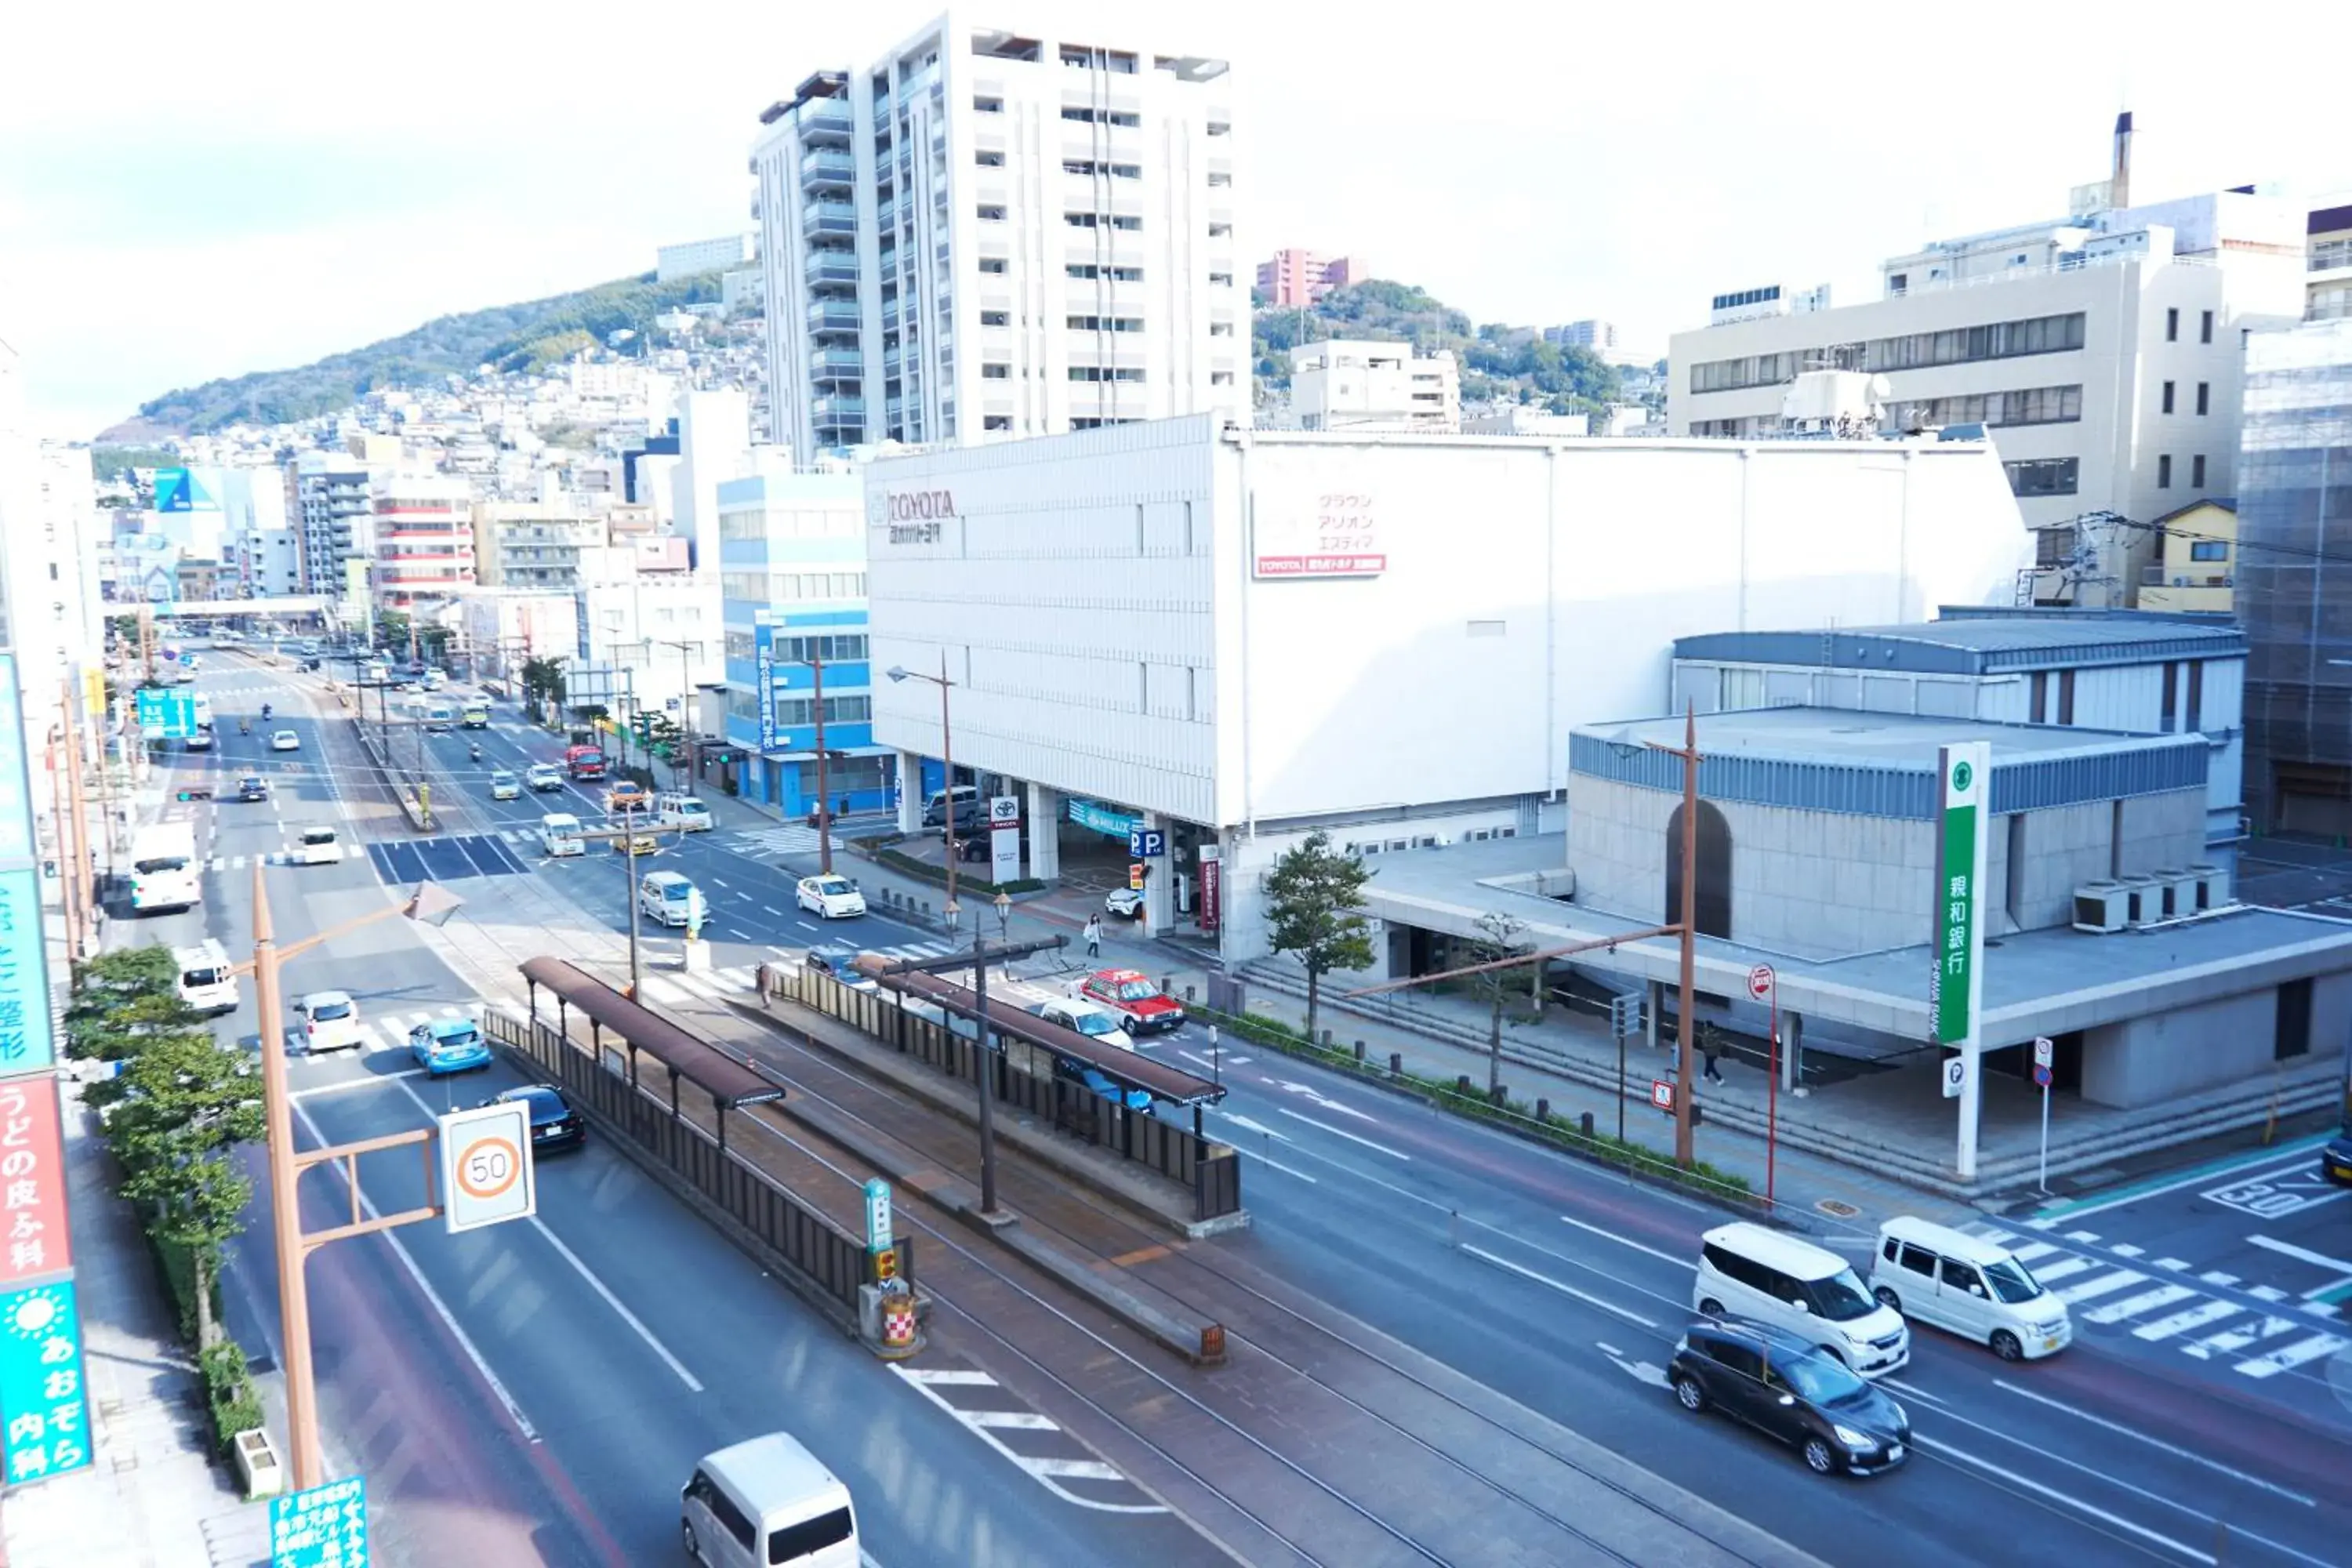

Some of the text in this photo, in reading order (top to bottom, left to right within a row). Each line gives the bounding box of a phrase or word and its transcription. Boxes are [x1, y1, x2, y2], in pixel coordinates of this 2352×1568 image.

[888, 490, 955, 521] TOYOTA
[1319, 494, 1372, 508] クラウン
[1318, 514, 1373, 530] アリオン
[1319, 535, 1373, 551] エスティマ
[1145, 833, 1160, 854] P
[1947, 875, 1967, 975] 親和銀行
[472, 1153, 506, 1182] 50
[9, 1411, 49, 1479] 内科
